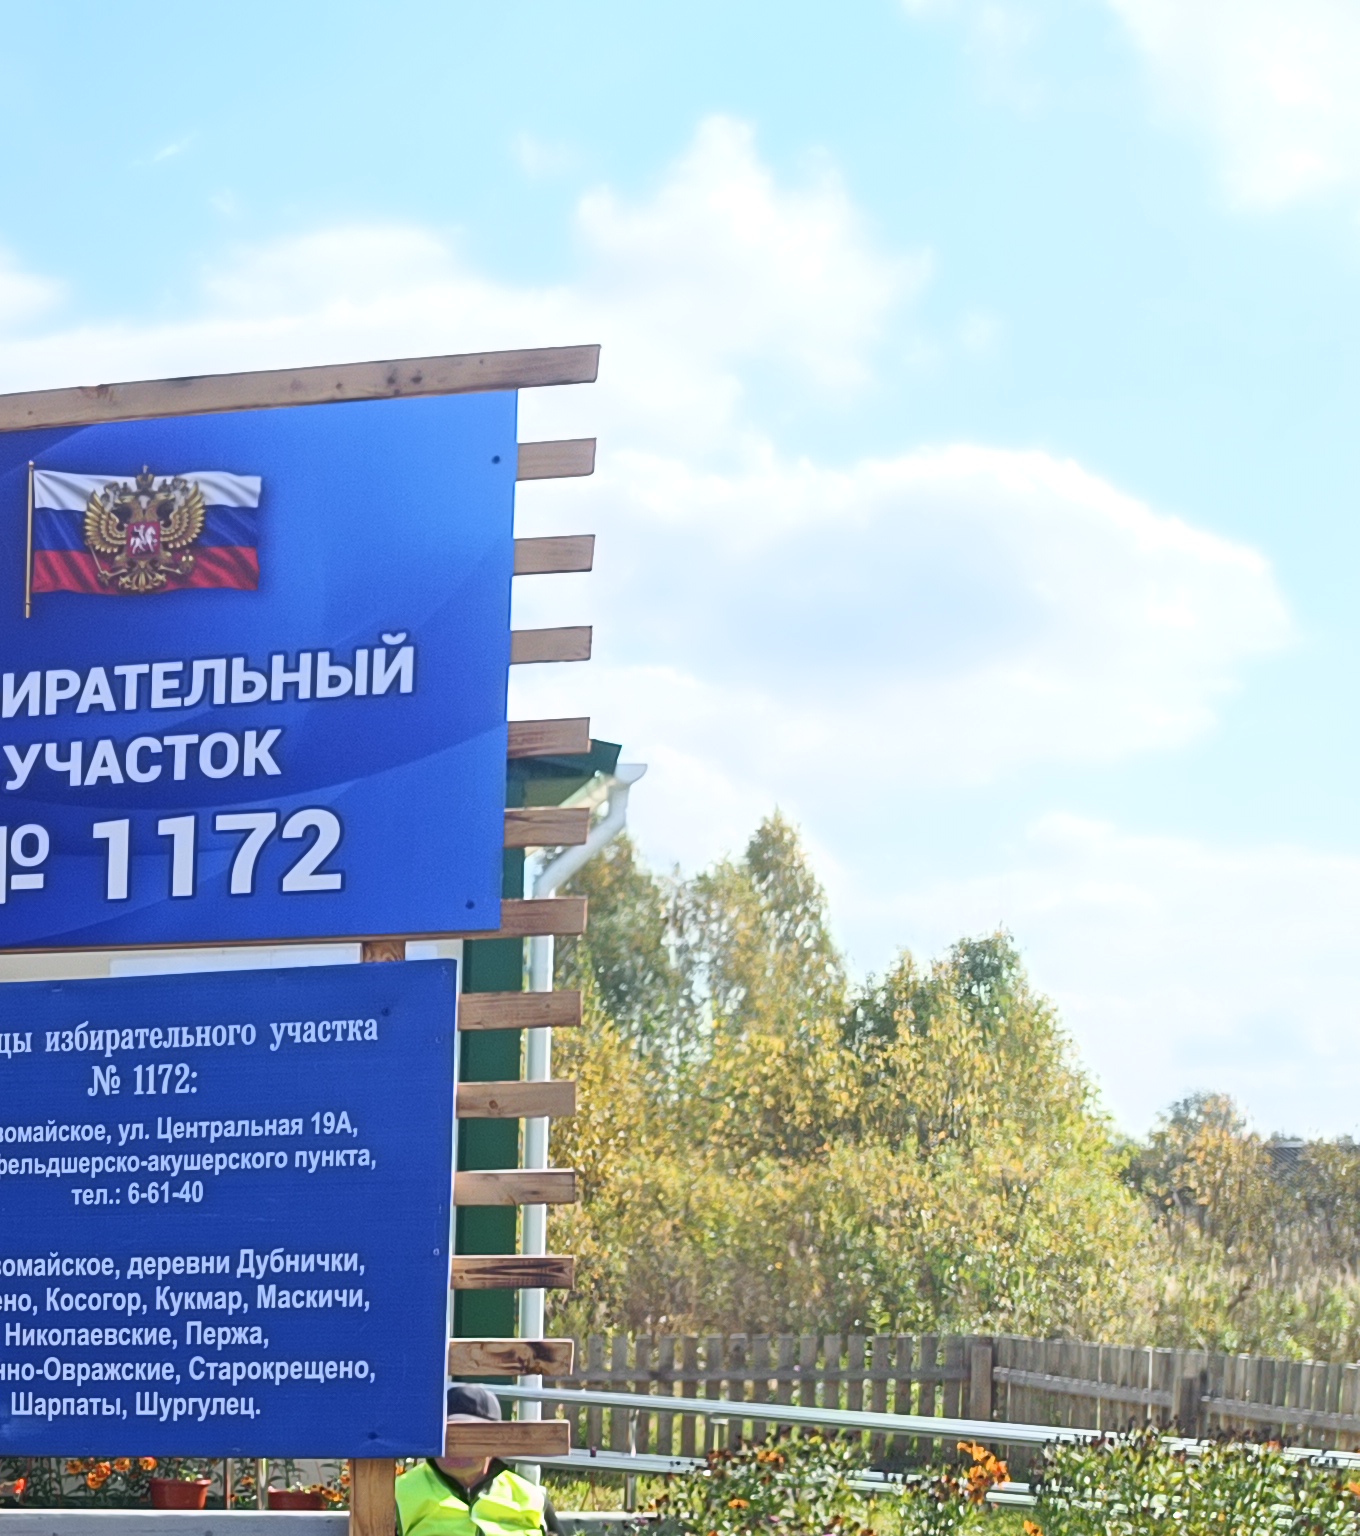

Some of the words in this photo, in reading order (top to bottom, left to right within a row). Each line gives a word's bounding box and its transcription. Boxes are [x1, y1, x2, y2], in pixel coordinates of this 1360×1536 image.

[3, 729, 281, 790] УЧАСТОК
[93, 809, 341, 899] 1172
[44, 1020, 257, 1058] избирательного
[269, 1018, 378, 1052] участка
[87, 1064, 121, 1097] №
[133, 1062, 198, 1095] 1172:
[118, 1123, 150, 1147] ул.
[157, 1116, 304, 1144] Центральная
[310, 1110, 358, 1138] 19А,
[294, 1148, 376, 1174] пункта,
[70, 1186, 121, 1206] тел.:
[127, 1180, 204, 1205] 6-61-40
[126, 1255, 230, 1281] деревни
[236, 1247, 365, 1280] Дубнички,
[46, 1287, 148, 1317] Косогор,
[155, 1285, 249, 1317] Кукмар,
[256, 1283, 370, 1312] Маскичи,
[5, 1322, 178, 1350] Николаевские,
[186, 1320, 269, 1351] Пержа,
[188, 1355, 376, 1387] Старокрещено,
[11, 1391, 128, 1422] Шарпаты,
[135, 1391, 261, 1422] Шургулец.
